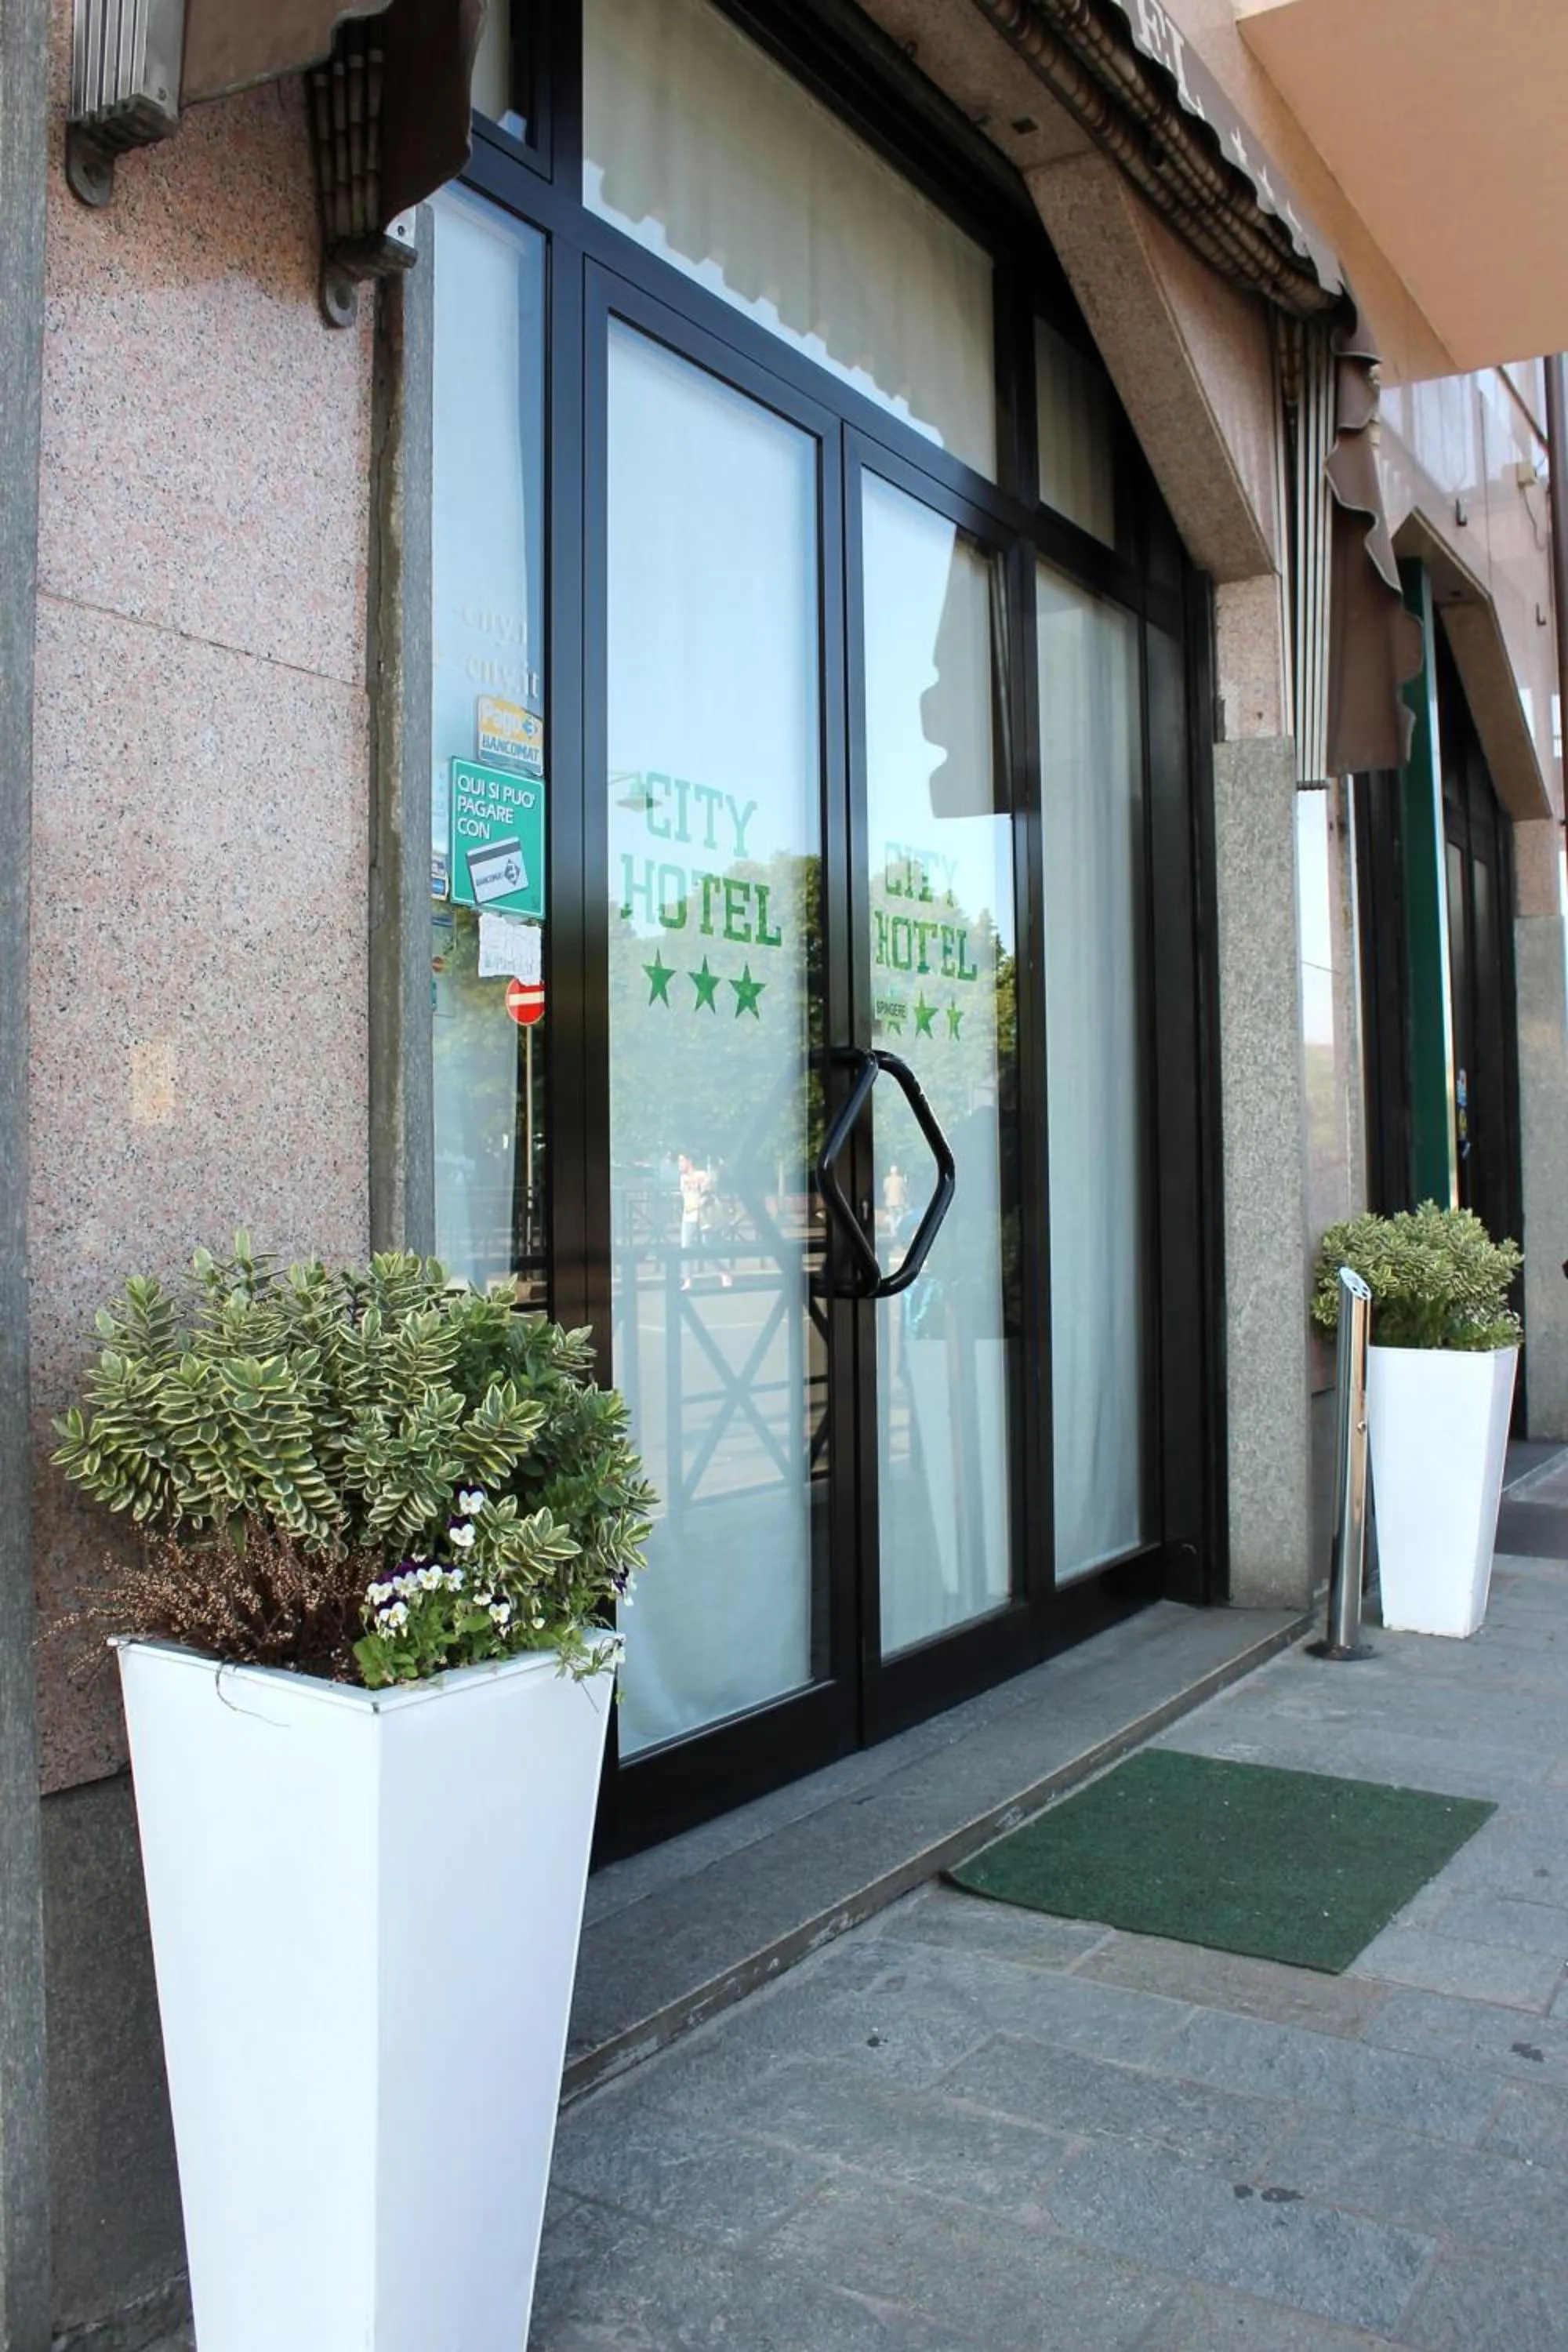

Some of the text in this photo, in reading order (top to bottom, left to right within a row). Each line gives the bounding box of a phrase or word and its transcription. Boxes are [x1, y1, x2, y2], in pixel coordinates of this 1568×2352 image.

[482, 732, 540, 763] BANCOMAT
[457, 775, 485, 795] QUI
[488, 782, 499, 798] SI
[457, 795, 514, 823] PAGARE
[457, 817, 491, 839] CON
[645, 771, 758, 858] CITY
[884, 840, 959, 908] CITY
[620, 852, 782, 947] HOTEL
[874, 910, 978, 981] HOTEL
